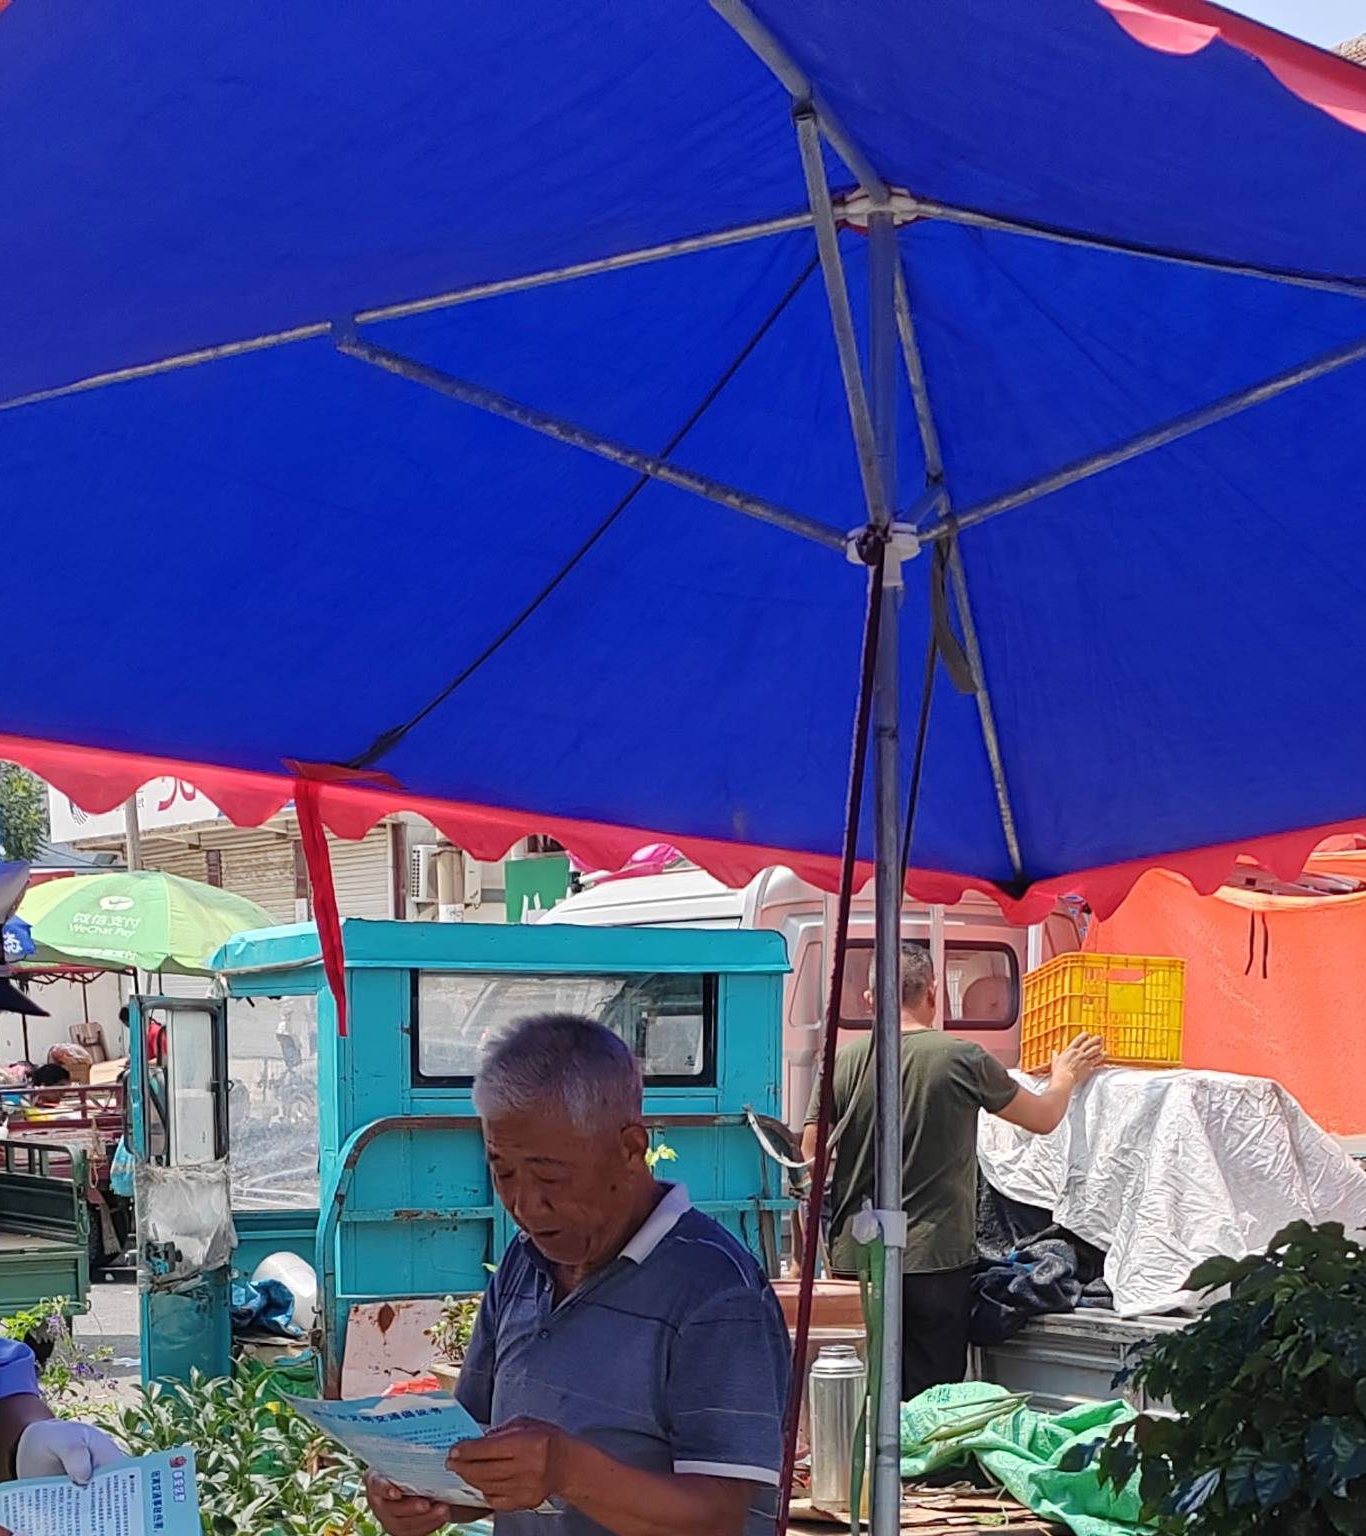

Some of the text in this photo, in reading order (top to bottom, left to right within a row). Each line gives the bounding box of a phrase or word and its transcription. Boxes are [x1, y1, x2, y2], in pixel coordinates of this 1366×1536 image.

[73, 912, 141, 928] 微信支付
[69, 924, 114, 936] WeChat
